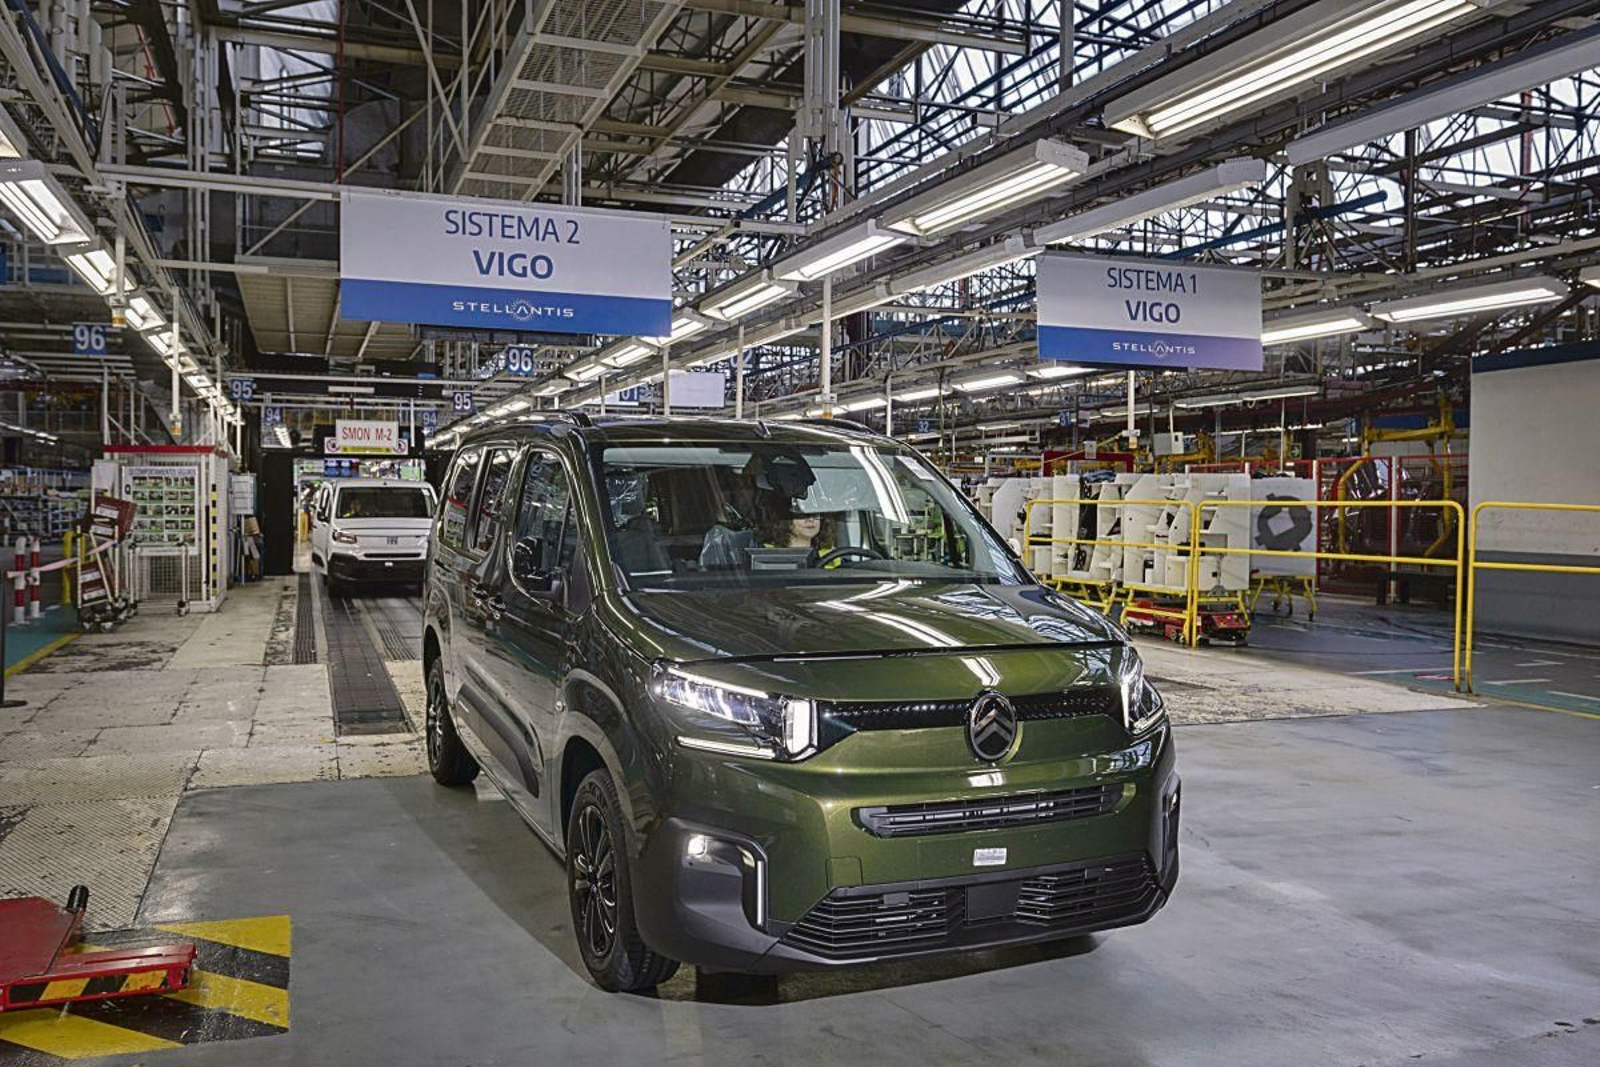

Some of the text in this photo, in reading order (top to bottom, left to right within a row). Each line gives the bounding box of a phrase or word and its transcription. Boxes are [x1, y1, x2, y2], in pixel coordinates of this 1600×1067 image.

[445, 209, 580, 245] SISTEMA 2
[473, 250, 554, 280] VIGO
[1107, 267, 1197, 294] SISTEMA 1
[452, 301, 575, 318] STELLANTIS
[1125, 300, 1181, 324] VIGO
[75, 325, 105, 350] 96
[1112, 341, 1196, 355] STELLANTIS
[508, 350, 533, 372] 96
[232, 380, 252, 398] 95
[454, 392, 472, 411] 95
[266, 407, 281, 422] 94
[423, 411, 437, 426] 94
[342, 426, 392, 442] SMON M-2
